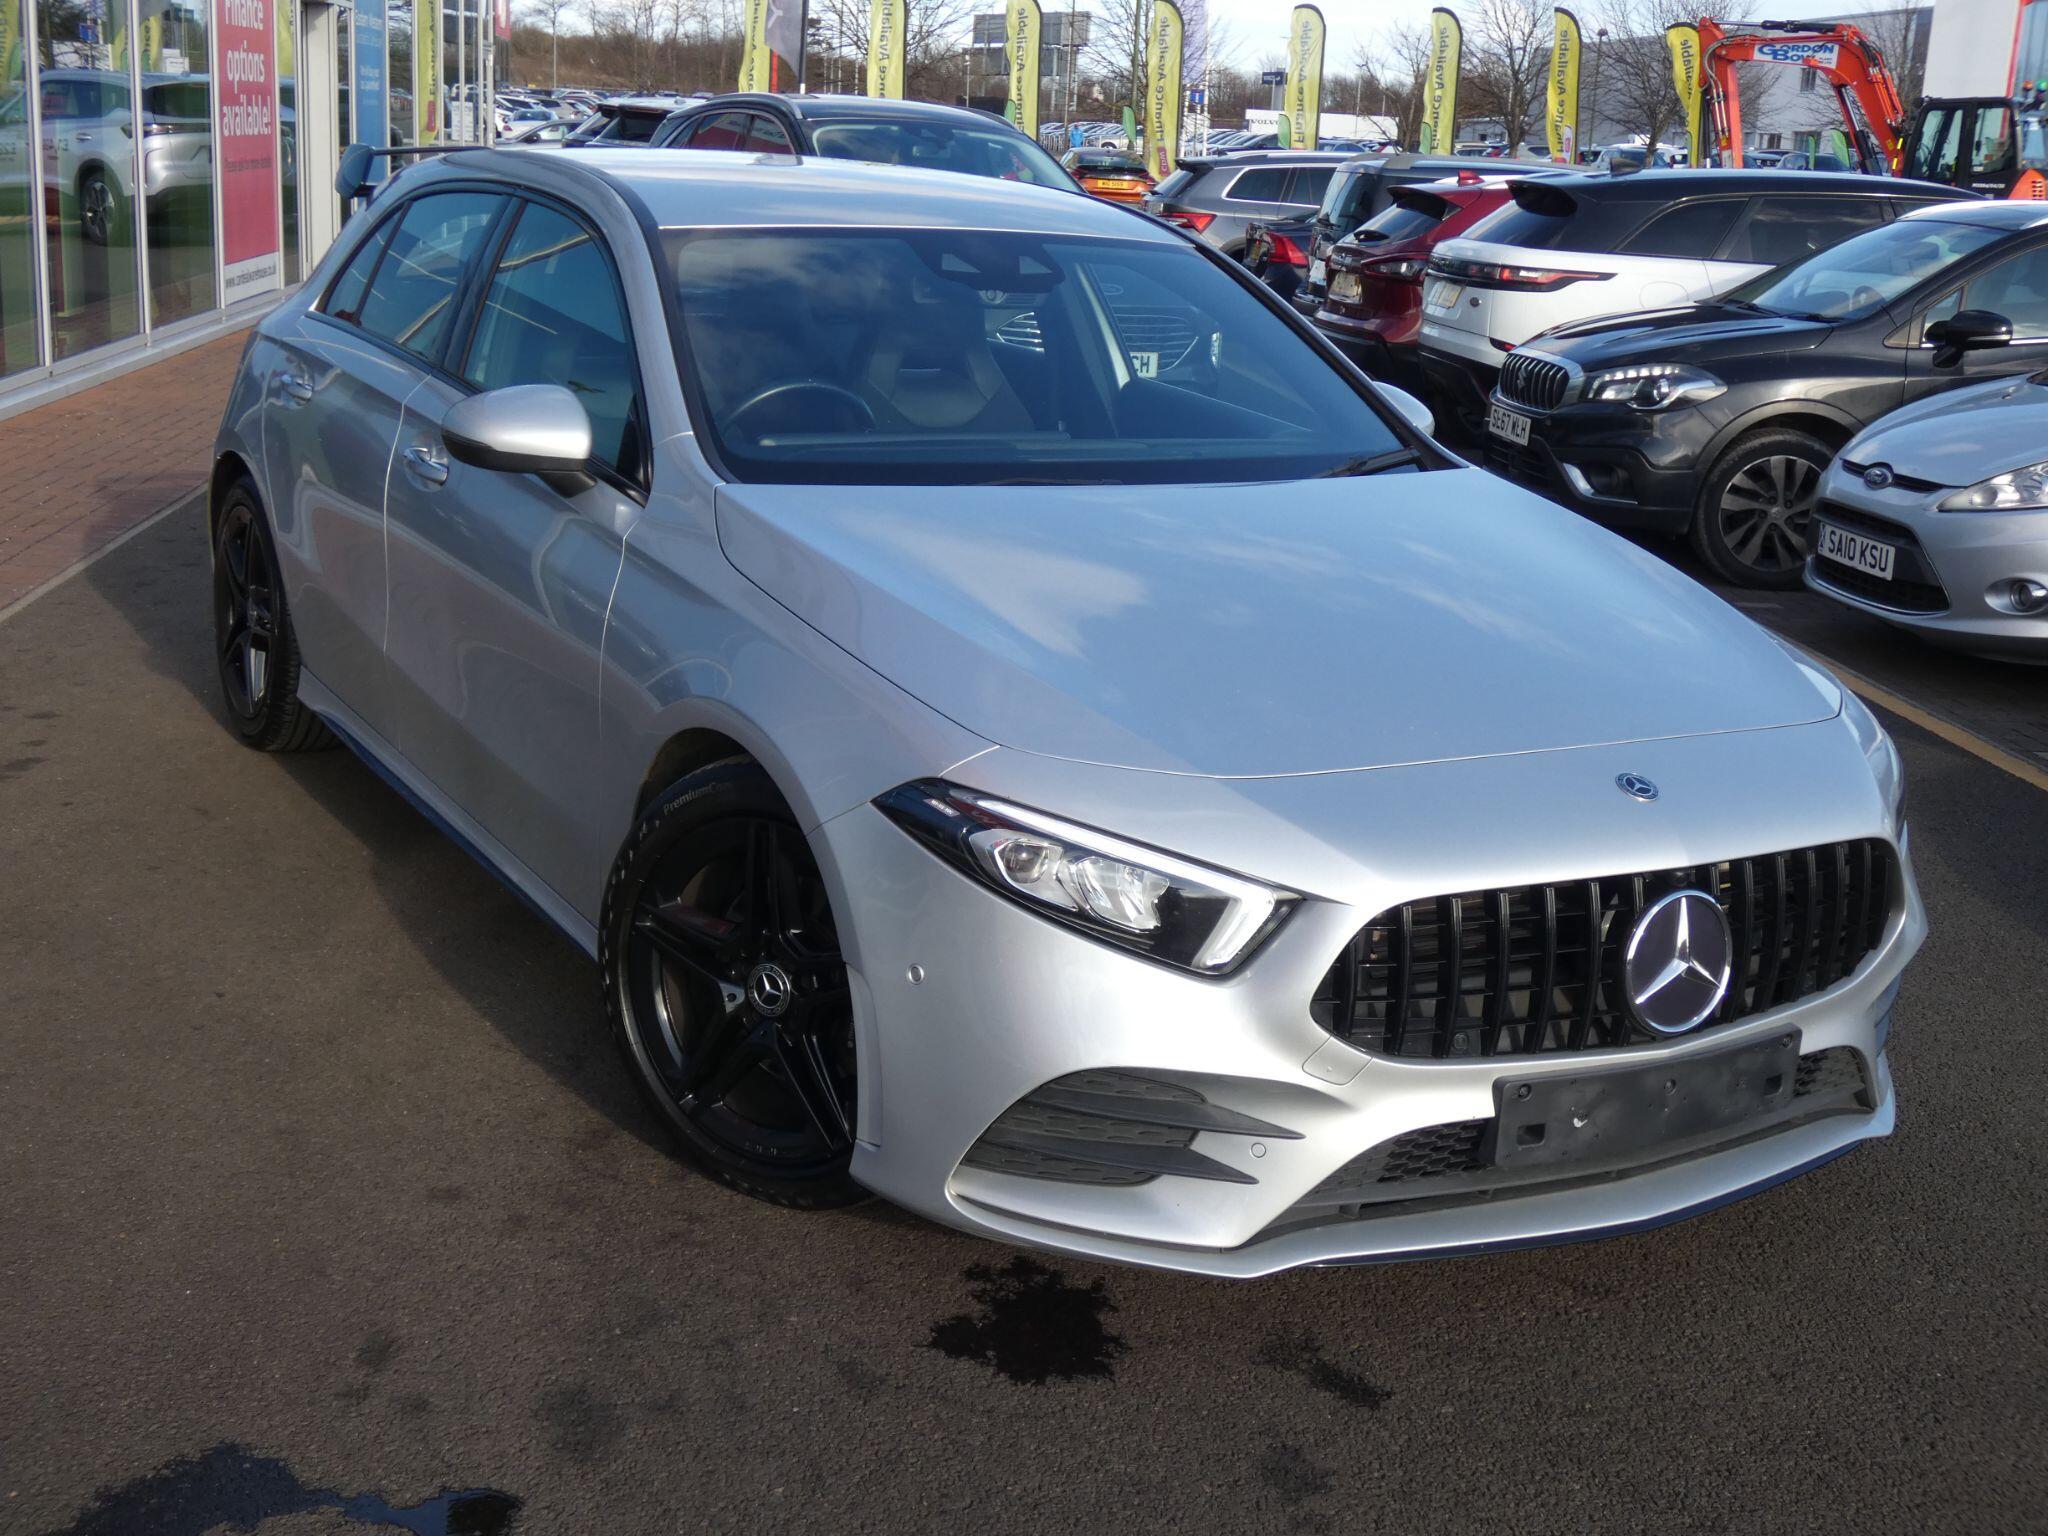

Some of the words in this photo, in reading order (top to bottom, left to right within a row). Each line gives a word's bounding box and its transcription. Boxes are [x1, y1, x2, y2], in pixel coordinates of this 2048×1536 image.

[225, 0, 263, 30] Finance
[227, 40, 265, 93] options
[1758, 43, 1834, 55] GORDON
[222, 94, 271, 136] available!
[1828, 530, 1858, 561] SA10
[1859, 542, 1890, 572] KSU
